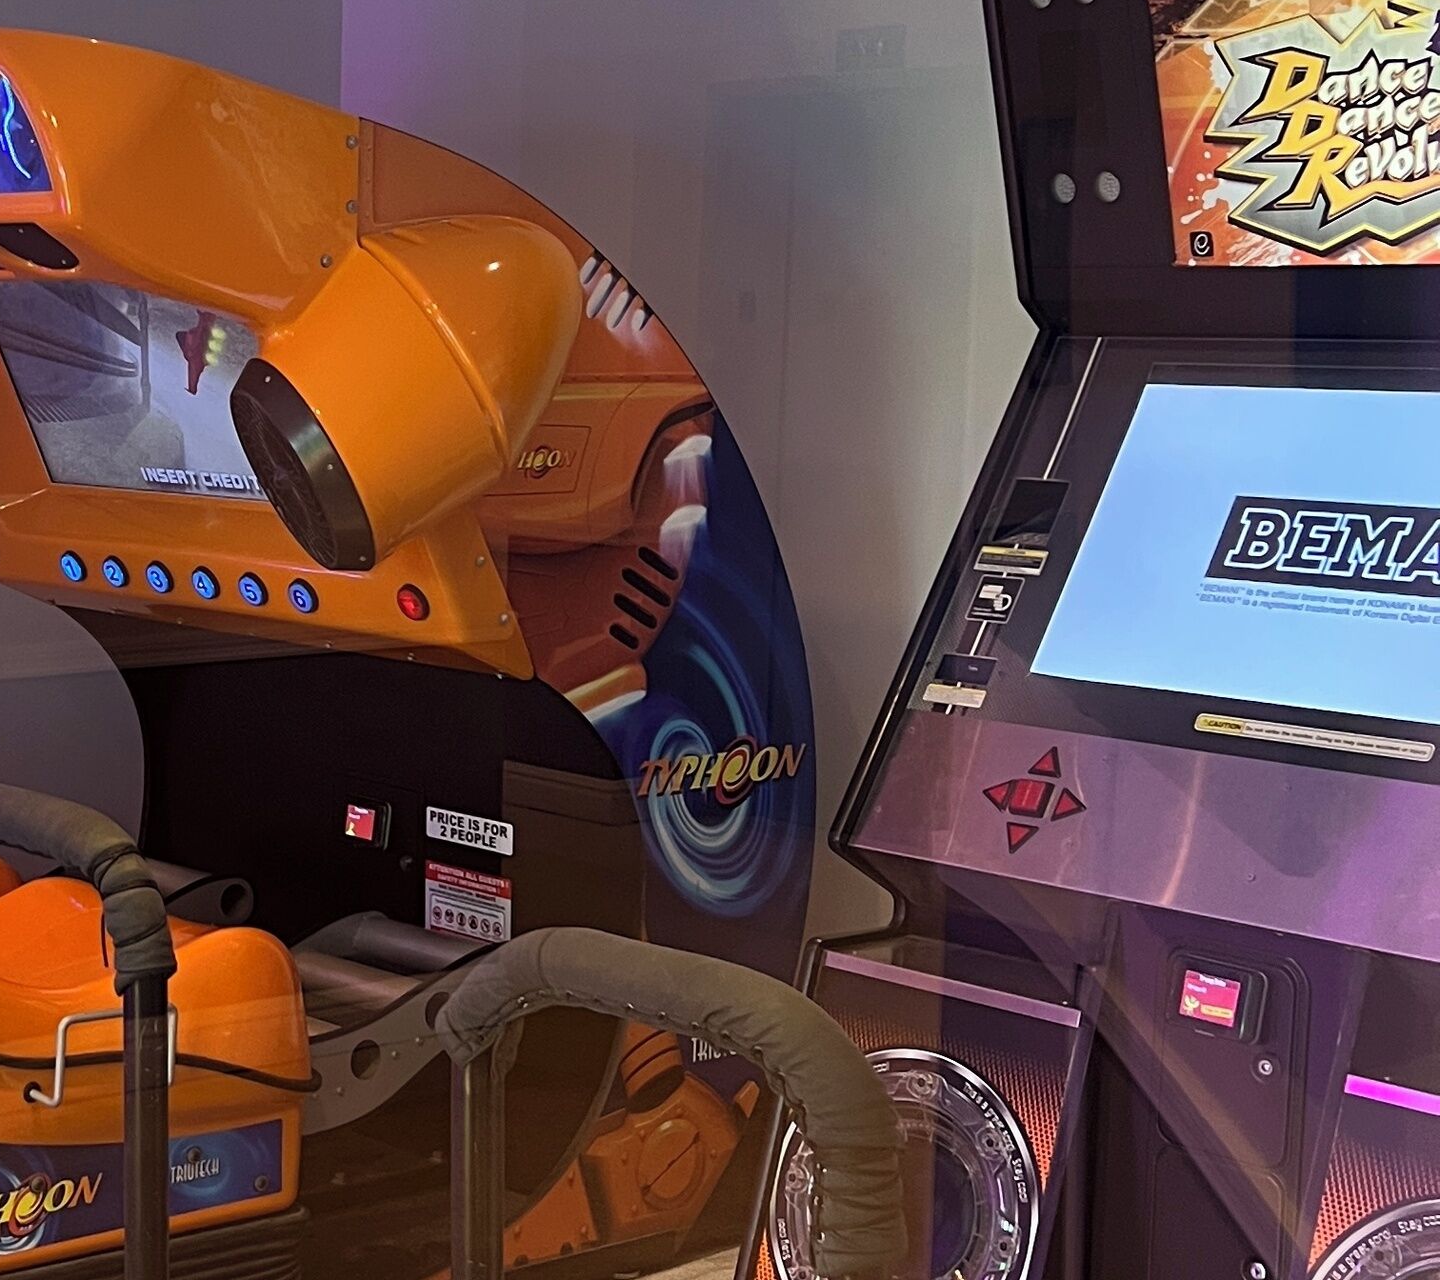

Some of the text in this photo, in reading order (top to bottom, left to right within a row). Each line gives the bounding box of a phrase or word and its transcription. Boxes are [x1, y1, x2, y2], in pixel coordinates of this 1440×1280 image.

[1246, 48, 1429, 119] Dance
[1265, 91, 1440, 157] Dance
[140, 466, 260, 490] INSERT CREDIT
[1223, 507, 1440, 585] BEMA
[65, 559, 78, 578] 1
[106, 565, 119, 582] 2
[152, 570, 163, 588] 3
[197, 576, 209, 593] 4
[244, 583, 258, 602] 5
[293, 589, 306, 608] 6
[1208, 719, 1242, 731] CAUTION
[637, 738, 807, 804] TYPHOON
[430, 810, 508, 838] PRICE IS FOR
[440, 825, 497, 848] 2 PEOPLE
